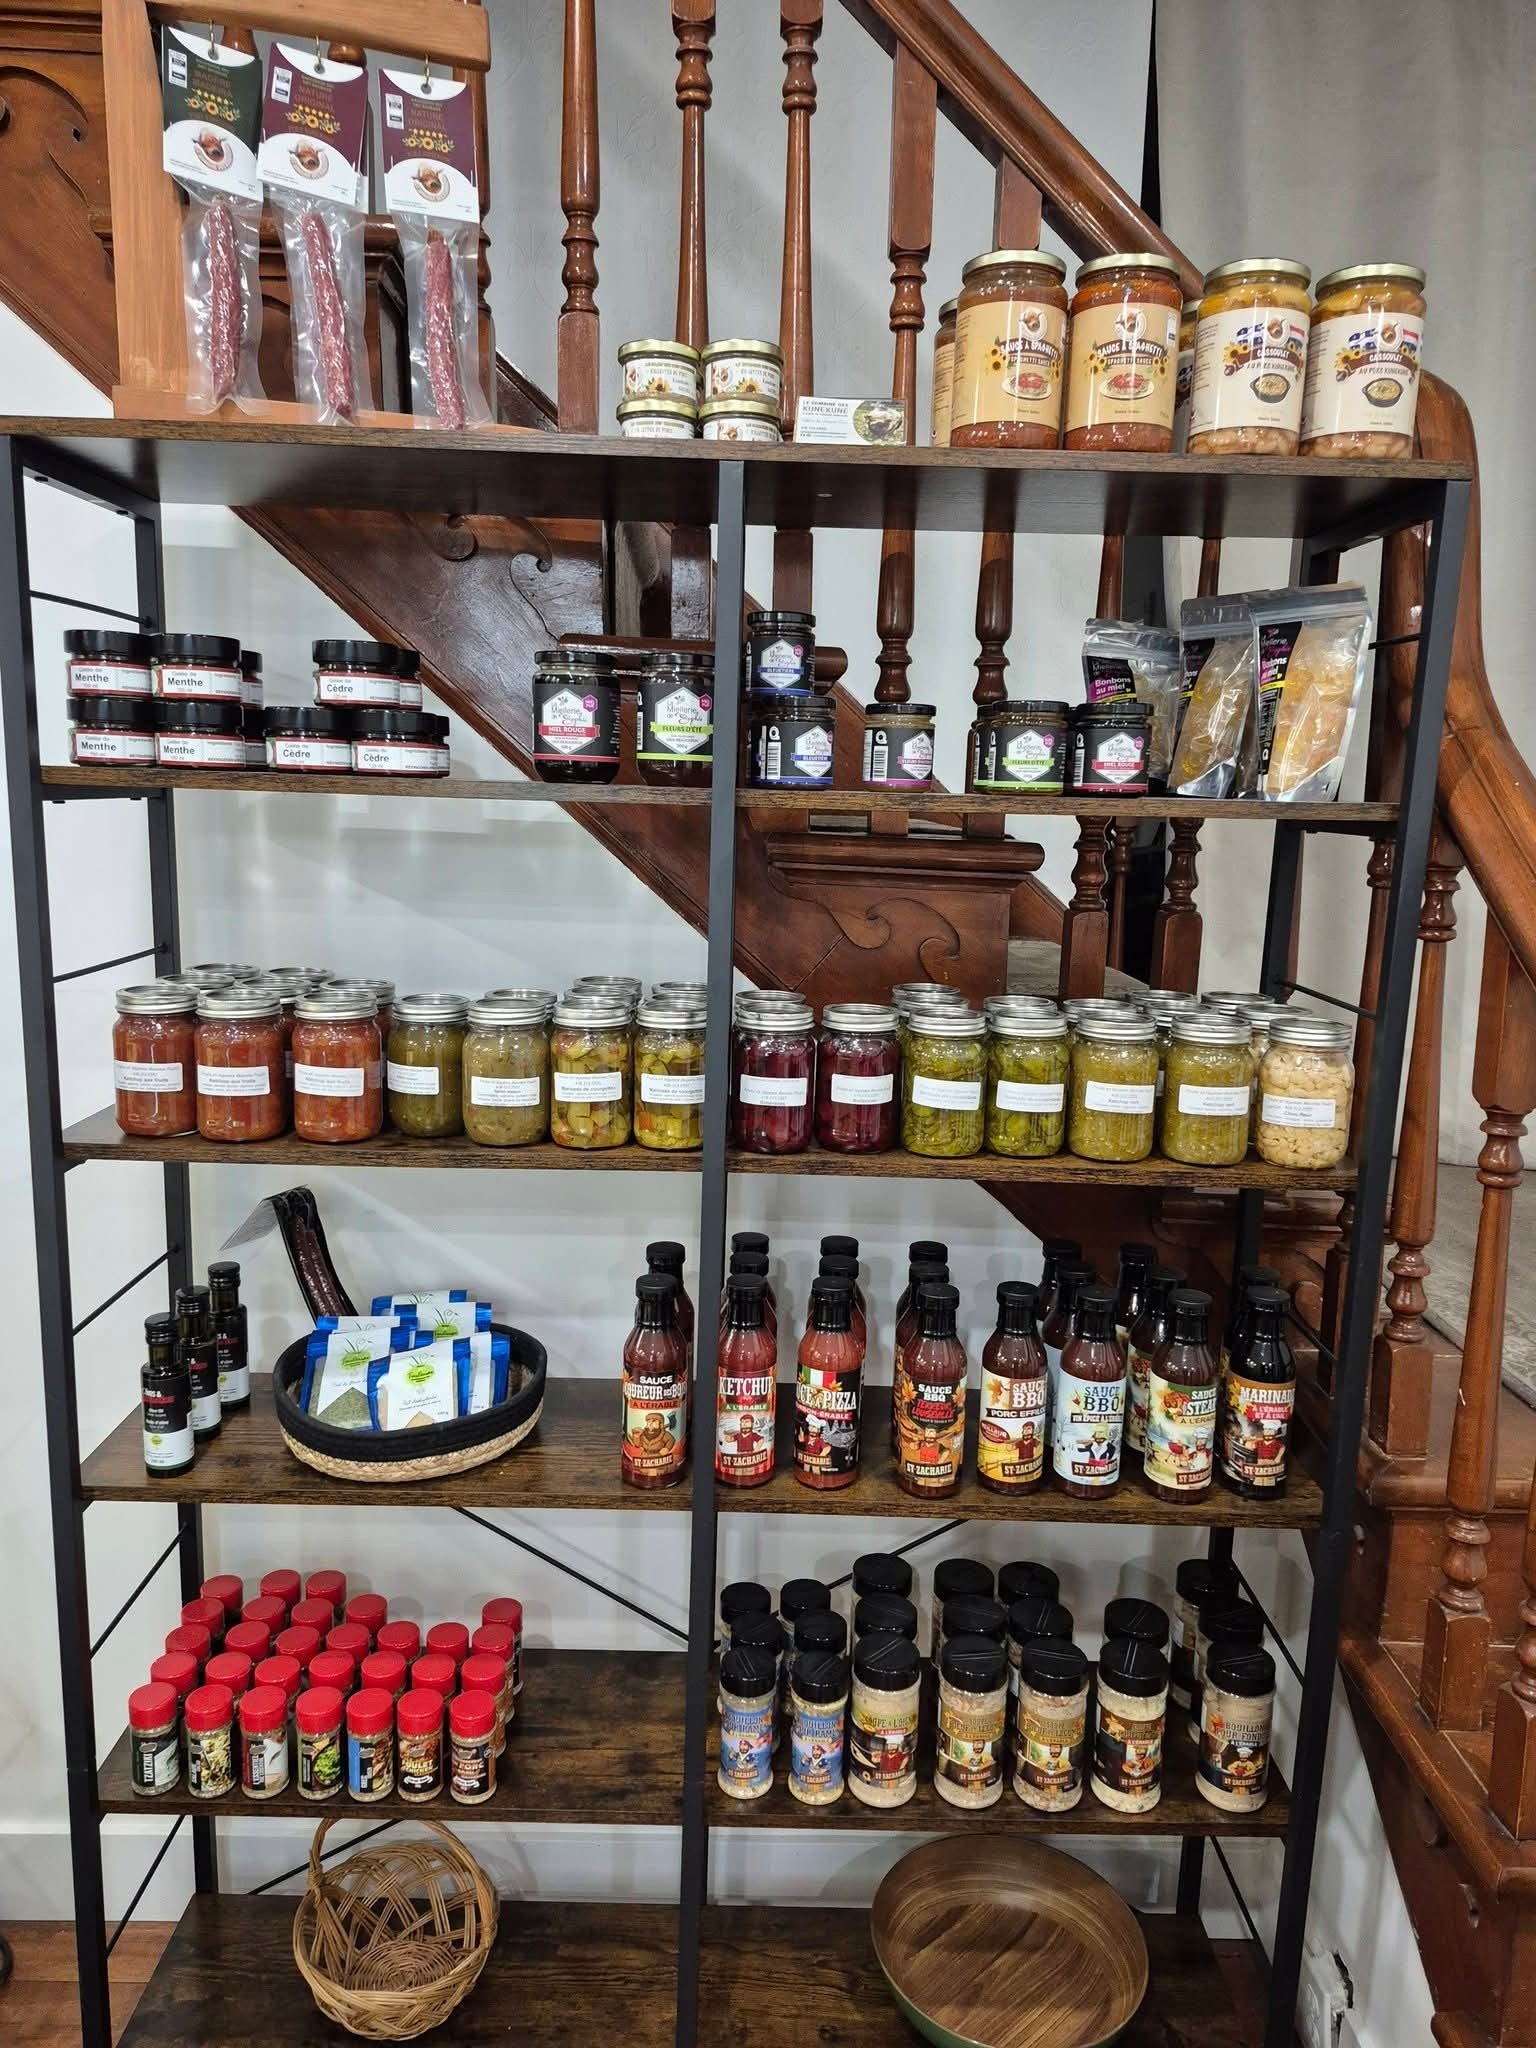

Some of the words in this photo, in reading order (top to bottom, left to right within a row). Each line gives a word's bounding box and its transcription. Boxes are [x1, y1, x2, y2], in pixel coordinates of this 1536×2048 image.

[1097, 342, 1120, 356] SAUCE
[75, 673, 110, 683] Menthe
[167, 677, 204, 687] Menthe
[1095, 677, 1131, 687] Bonbons
[1107, 683, 1126, 692] miel
[563, 726, 586, 734] ROUGE
[81, 741, 117, 752] Menthe
[163, 745, 196, 755] Menthe
[639, 1375, 673, 1385] SAUCE
[719, 1376, 774, 1396] KETCHUP
[918, 1383, 952, 1395] SAUCE
[823, 1390, 857, 1411] PIZZA
[923, 1392, 947, 1403] BBQ
[1012, 1391, 1046, 1409] BBQ
[1240, 1387, 1295, 1404] MARINAD
[1083, 1395, 1120, 1412] BBQ
[991, 1409, 1017, 1418] PORC
[1226, 1720, 1265, 1733] BOUILLON
